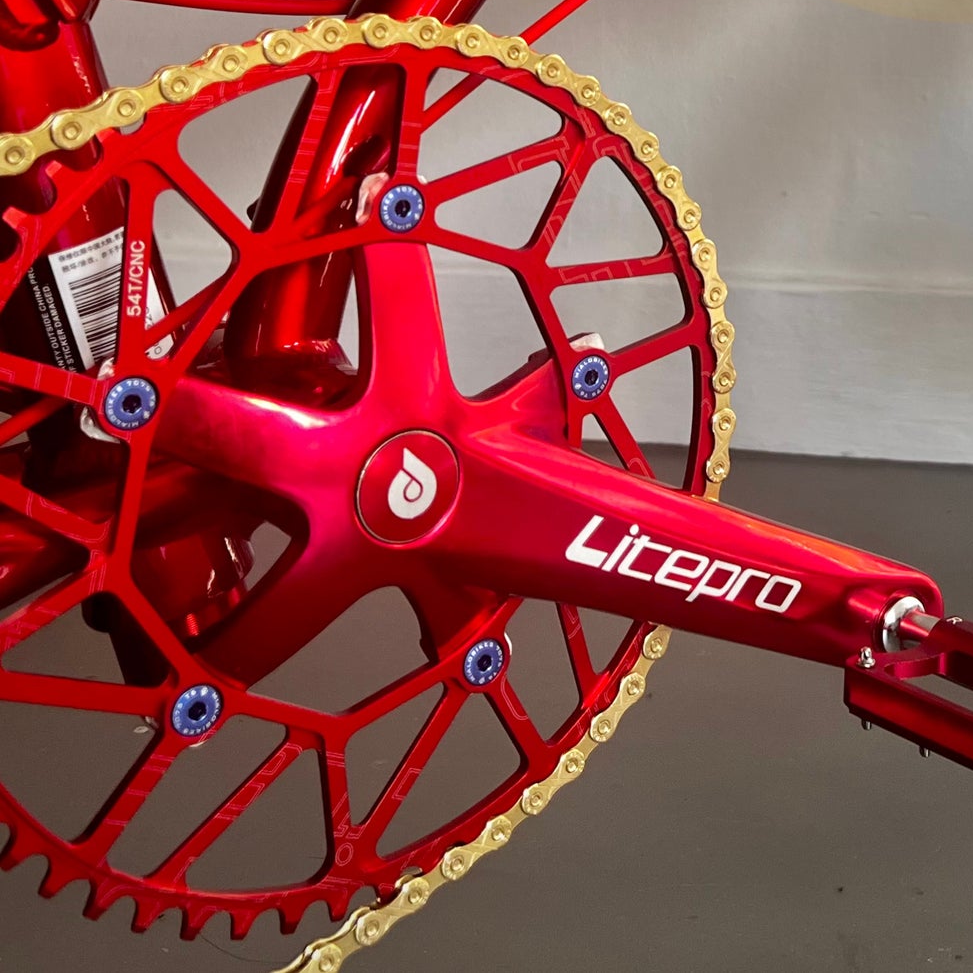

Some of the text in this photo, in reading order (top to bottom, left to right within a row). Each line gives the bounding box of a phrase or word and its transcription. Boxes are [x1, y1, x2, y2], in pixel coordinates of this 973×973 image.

[33, 284, 46, 311] CHINA
[127, 240, 145, 316] 54T/CNC
[56, 327, 74, 364] STICKER
[564, 515, 802, 614] Litepro
